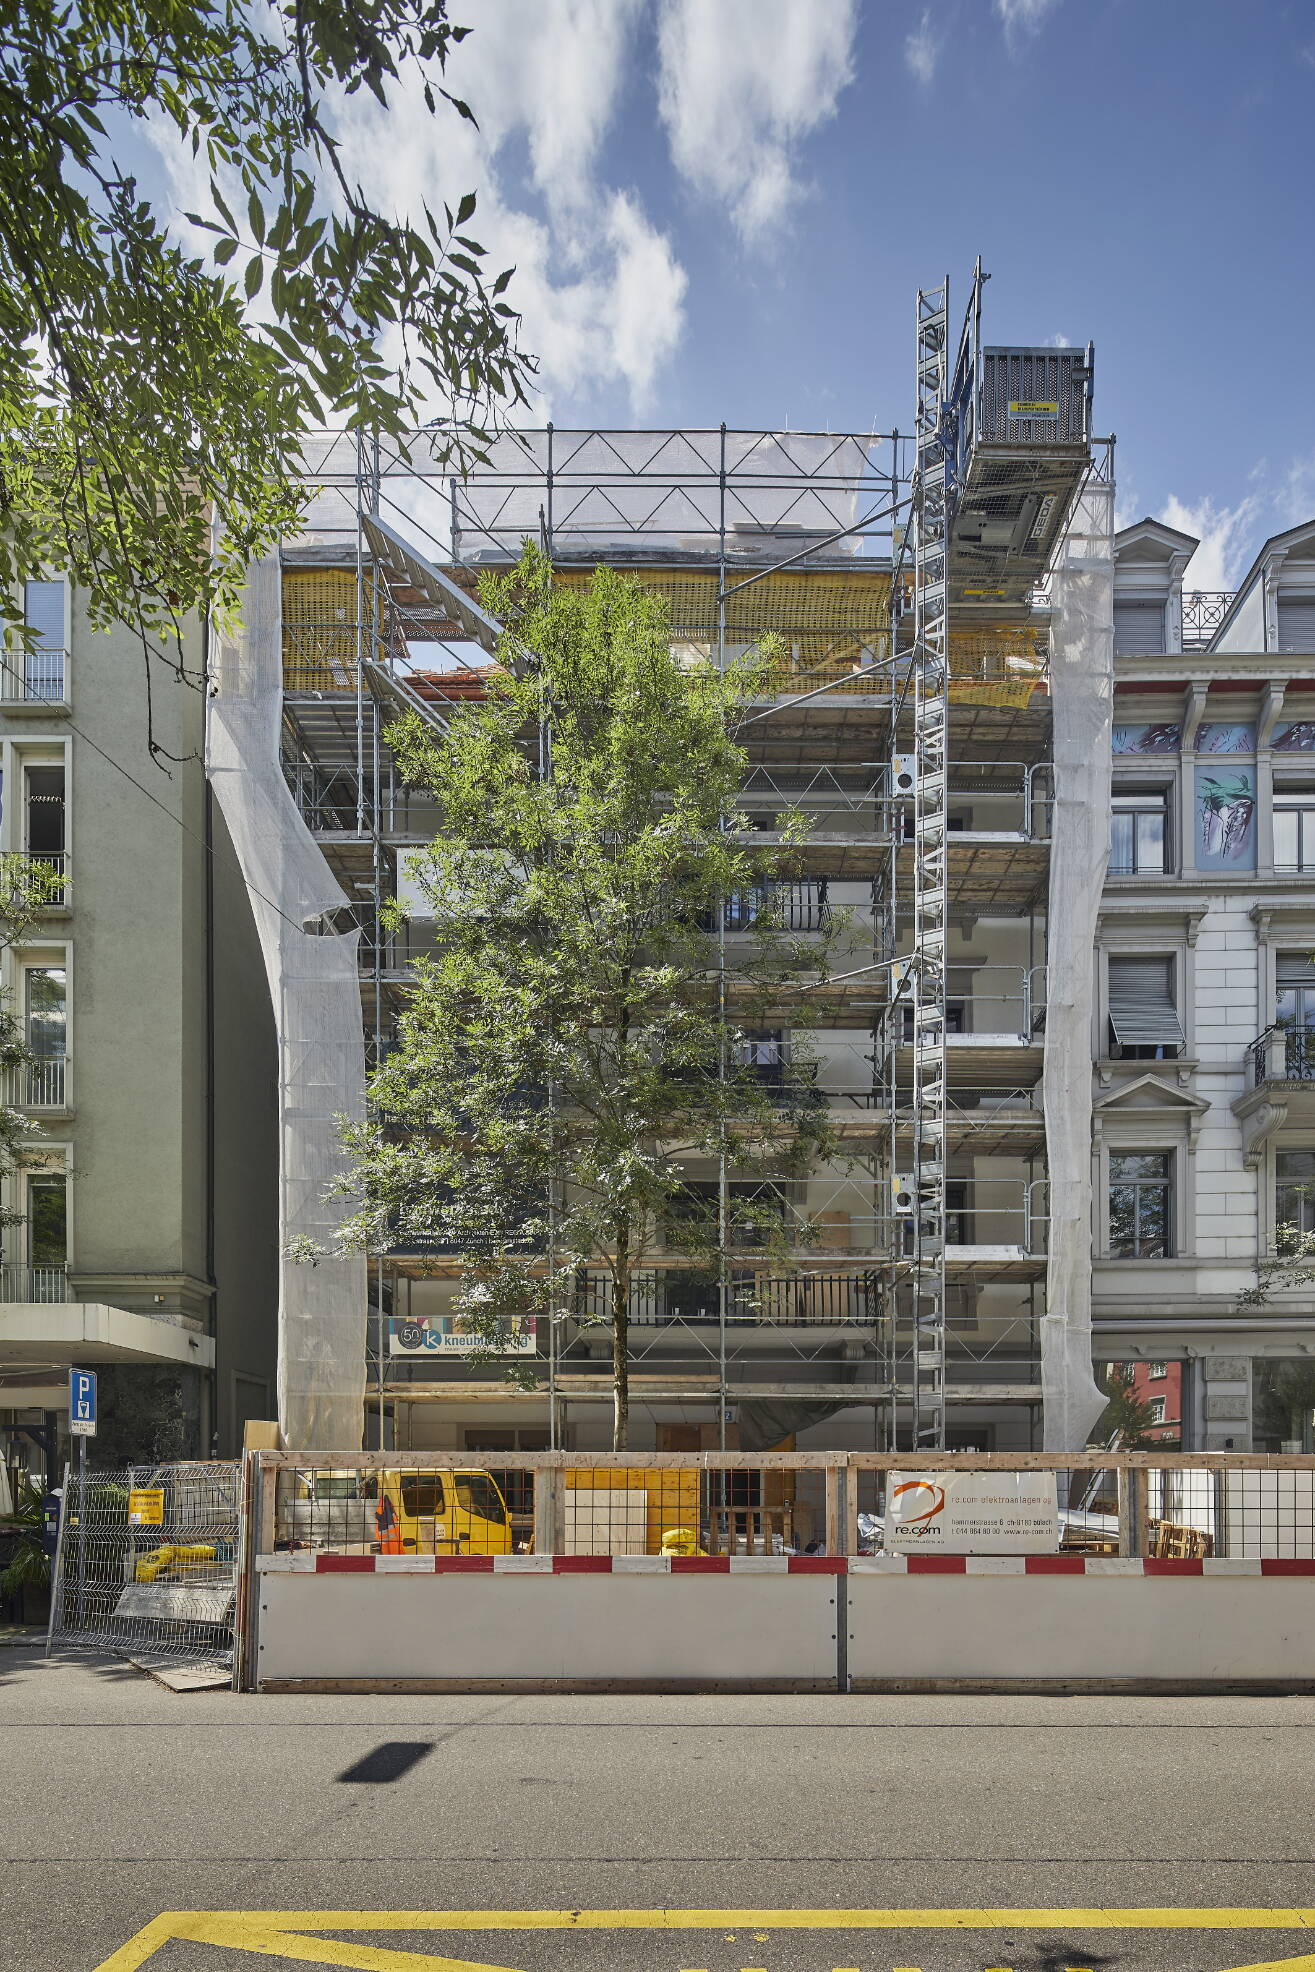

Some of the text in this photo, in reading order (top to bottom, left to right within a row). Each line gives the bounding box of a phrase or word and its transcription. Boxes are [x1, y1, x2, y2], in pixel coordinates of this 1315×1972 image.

[403, 1329, 419, 1342] 50
[79, 1376, 90, 1400] P
[895, 1526, 941, 1535] re.com
